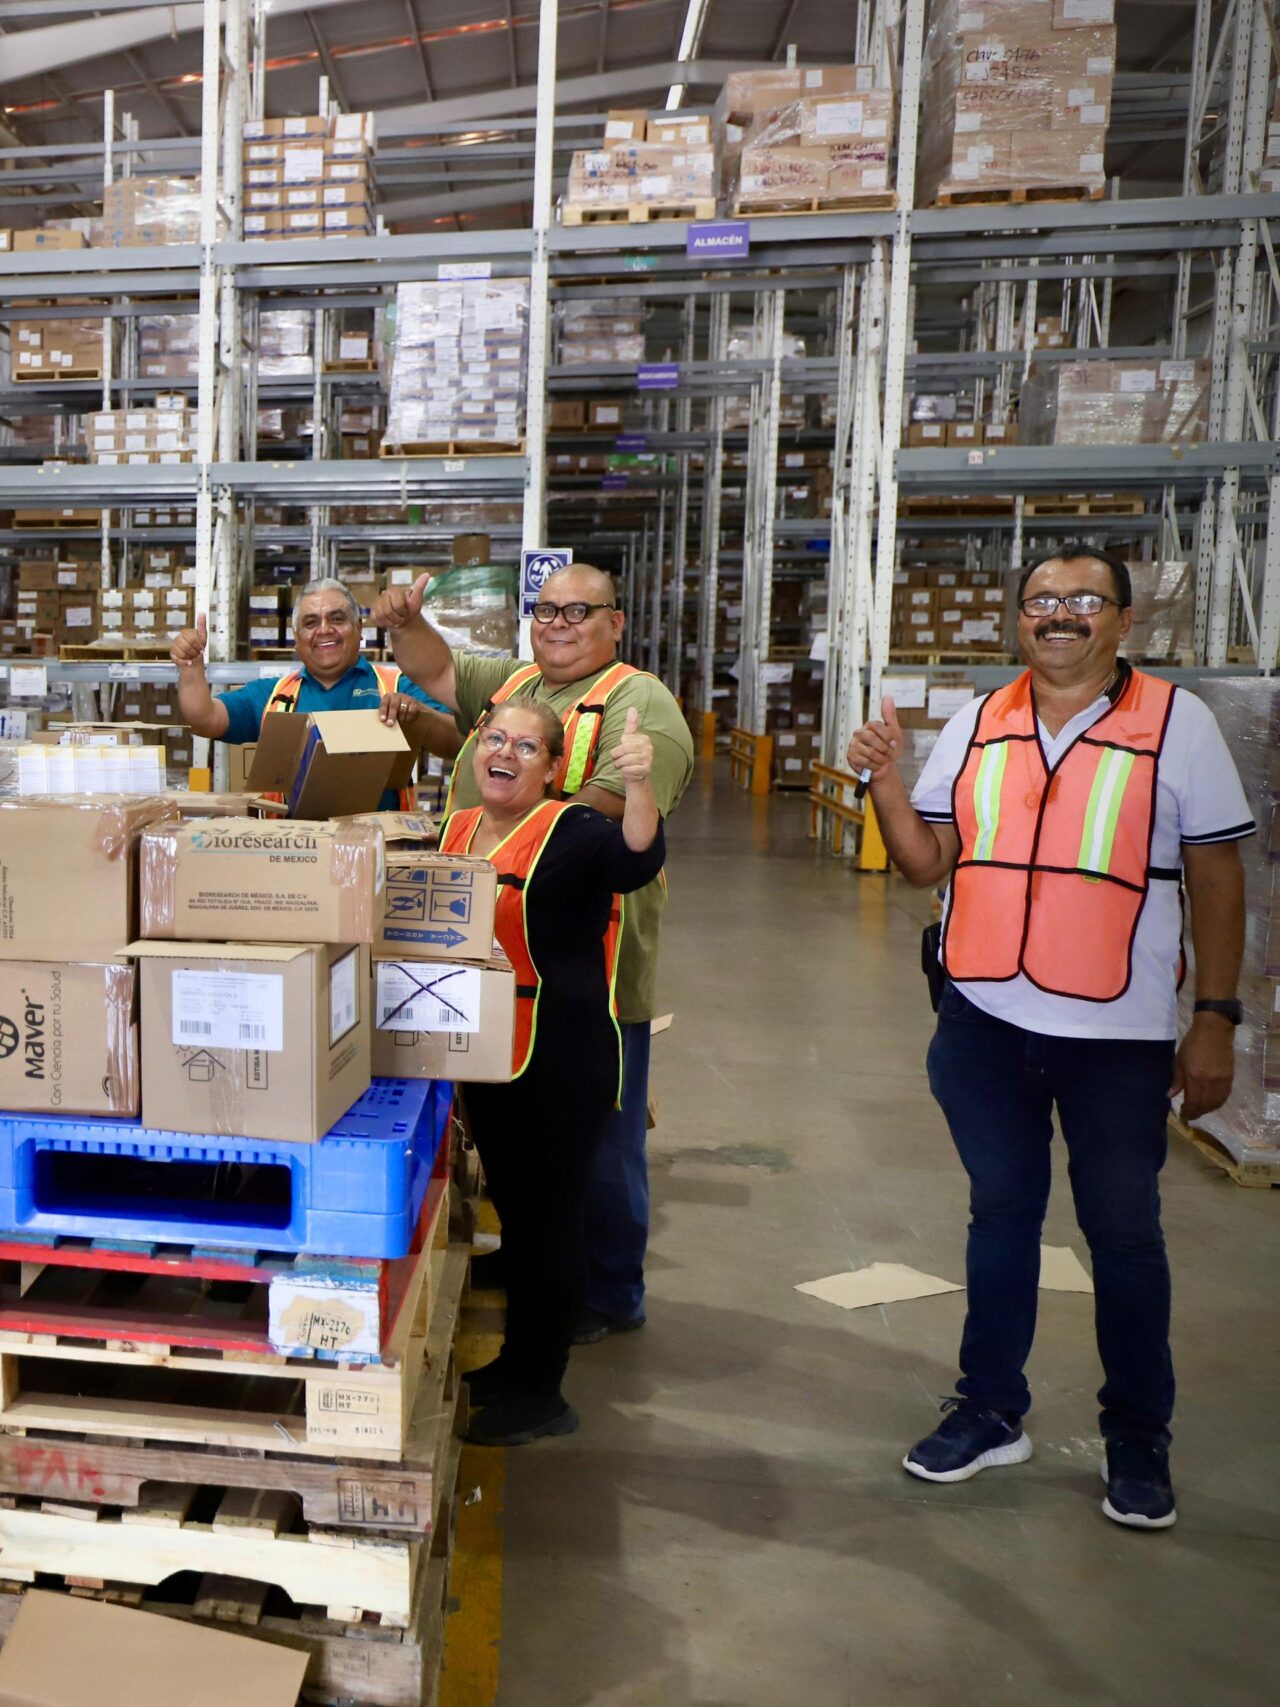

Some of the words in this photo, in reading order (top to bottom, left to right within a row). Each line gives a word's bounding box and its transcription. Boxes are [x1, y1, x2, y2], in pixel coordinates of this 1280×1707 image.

[694, 234, 743, 247] ALMACÉN
[269, 855, 282, 863] DE
[283, 855, 318, 864] MEXICO
[431, 933, 463, 941] HACIA
[50, 970, 62, 1001] Salud
[24, 995, 45, 1080] Maver
[52, 1016, 64, 1038] por
[51, 1040, 62, 1081] Ciencia
[253, 1055, 261, 1081] ESTIBA
[51, 1083, 62, 1106] Con
[320, 1334, 338, 1349] HT
[338, 1401, 352, 1409] HT
